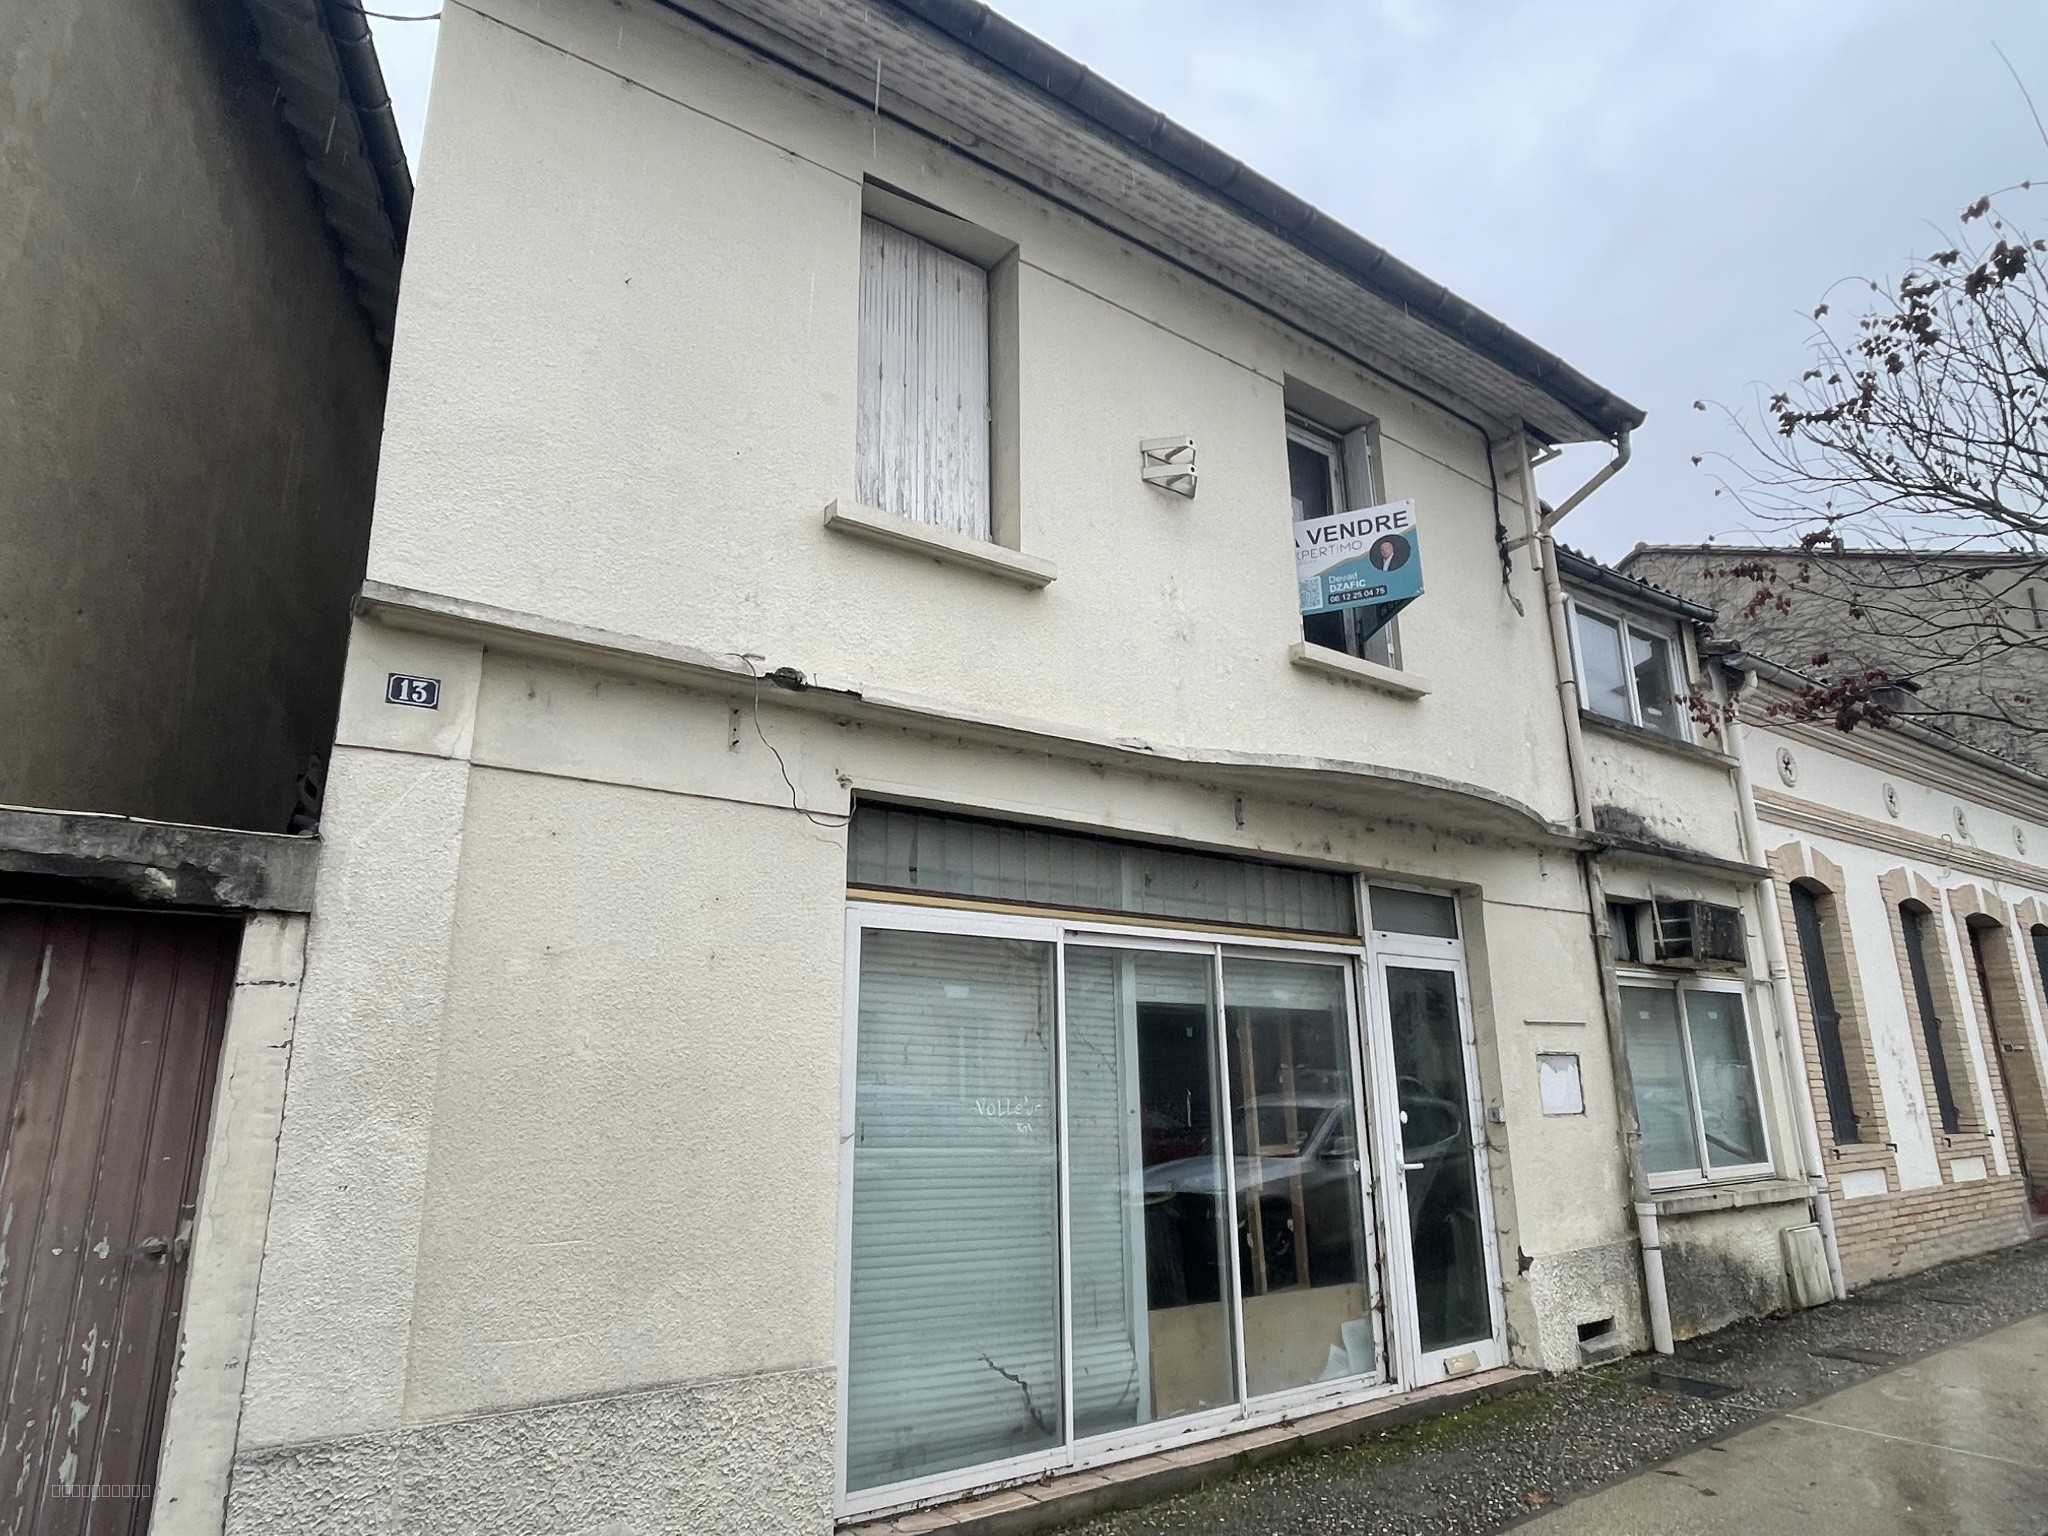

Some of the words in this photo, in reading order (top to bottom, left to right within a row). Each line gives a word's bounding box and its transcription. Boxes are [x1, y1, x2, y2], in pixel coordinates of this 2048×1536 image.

[1306, 511, 1408, 545] VENDRE
[1342, 592, 1352, 601] 12
[1353, 590, 1363, 600] 25
[399, 679, 428, 703] 13
